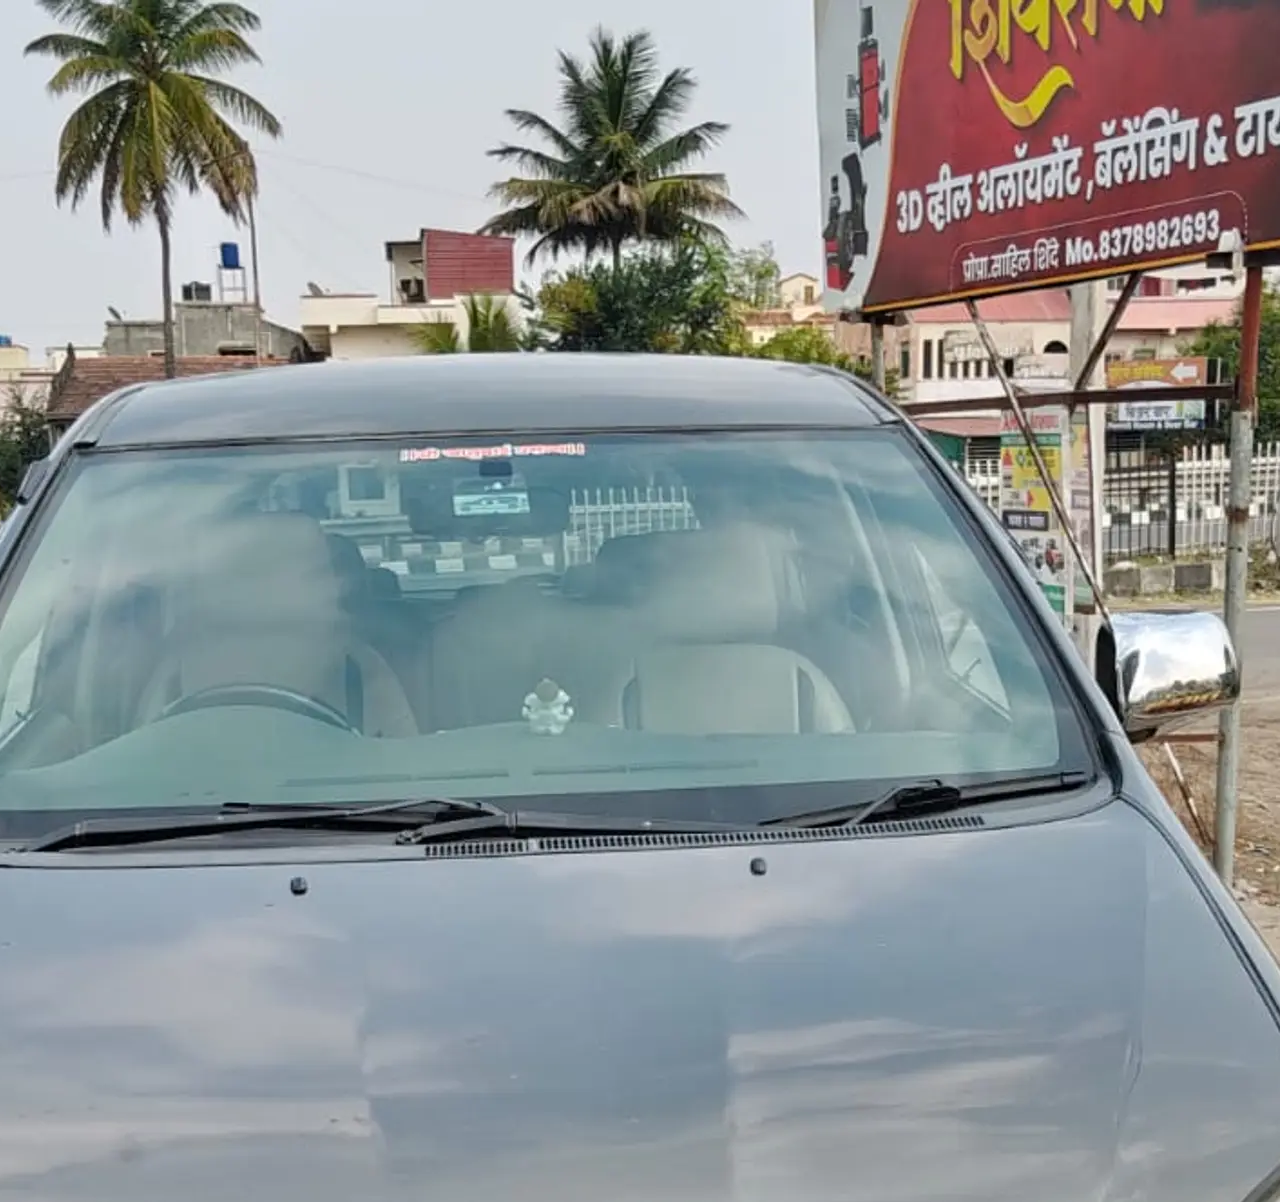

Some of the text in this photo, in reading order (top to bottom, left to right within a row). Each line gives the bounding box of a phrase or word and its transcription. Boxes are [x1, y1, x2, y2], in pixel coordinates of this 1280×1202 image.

[896, 189, 924, 233] 3D
[926, 163, 973, 232] व्हील
[1203, 114, 1229, 166] &
